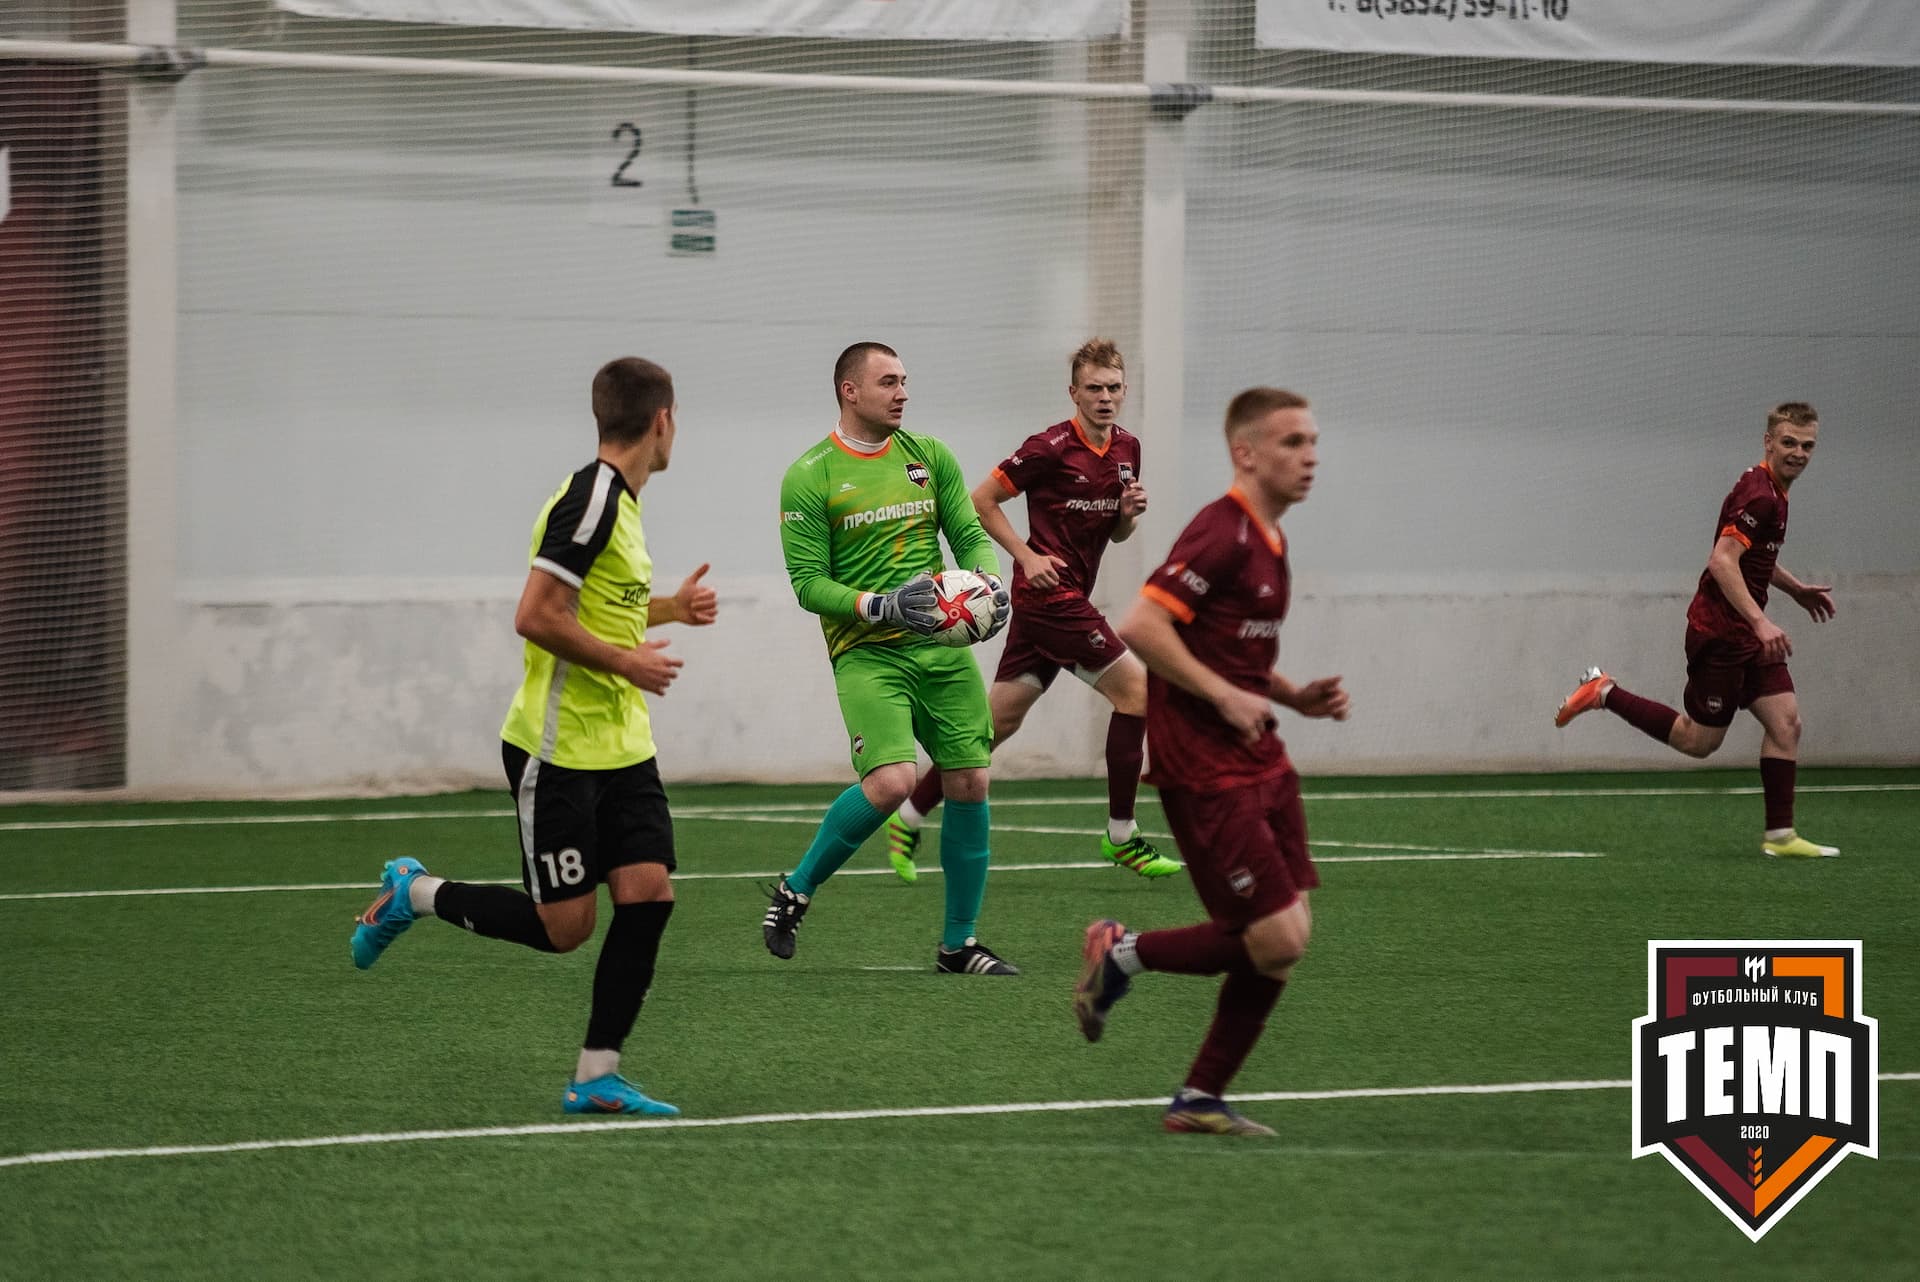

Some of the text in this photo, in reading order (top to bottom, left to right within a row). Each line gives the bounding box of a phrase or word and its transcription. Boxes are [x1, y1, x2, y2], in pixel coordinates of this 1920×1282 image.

[611, 121, 643, 187] 2
[843, 498, 936, 530] ПРОДИНВЕСТ
[540, 847, 586, 889] 18
